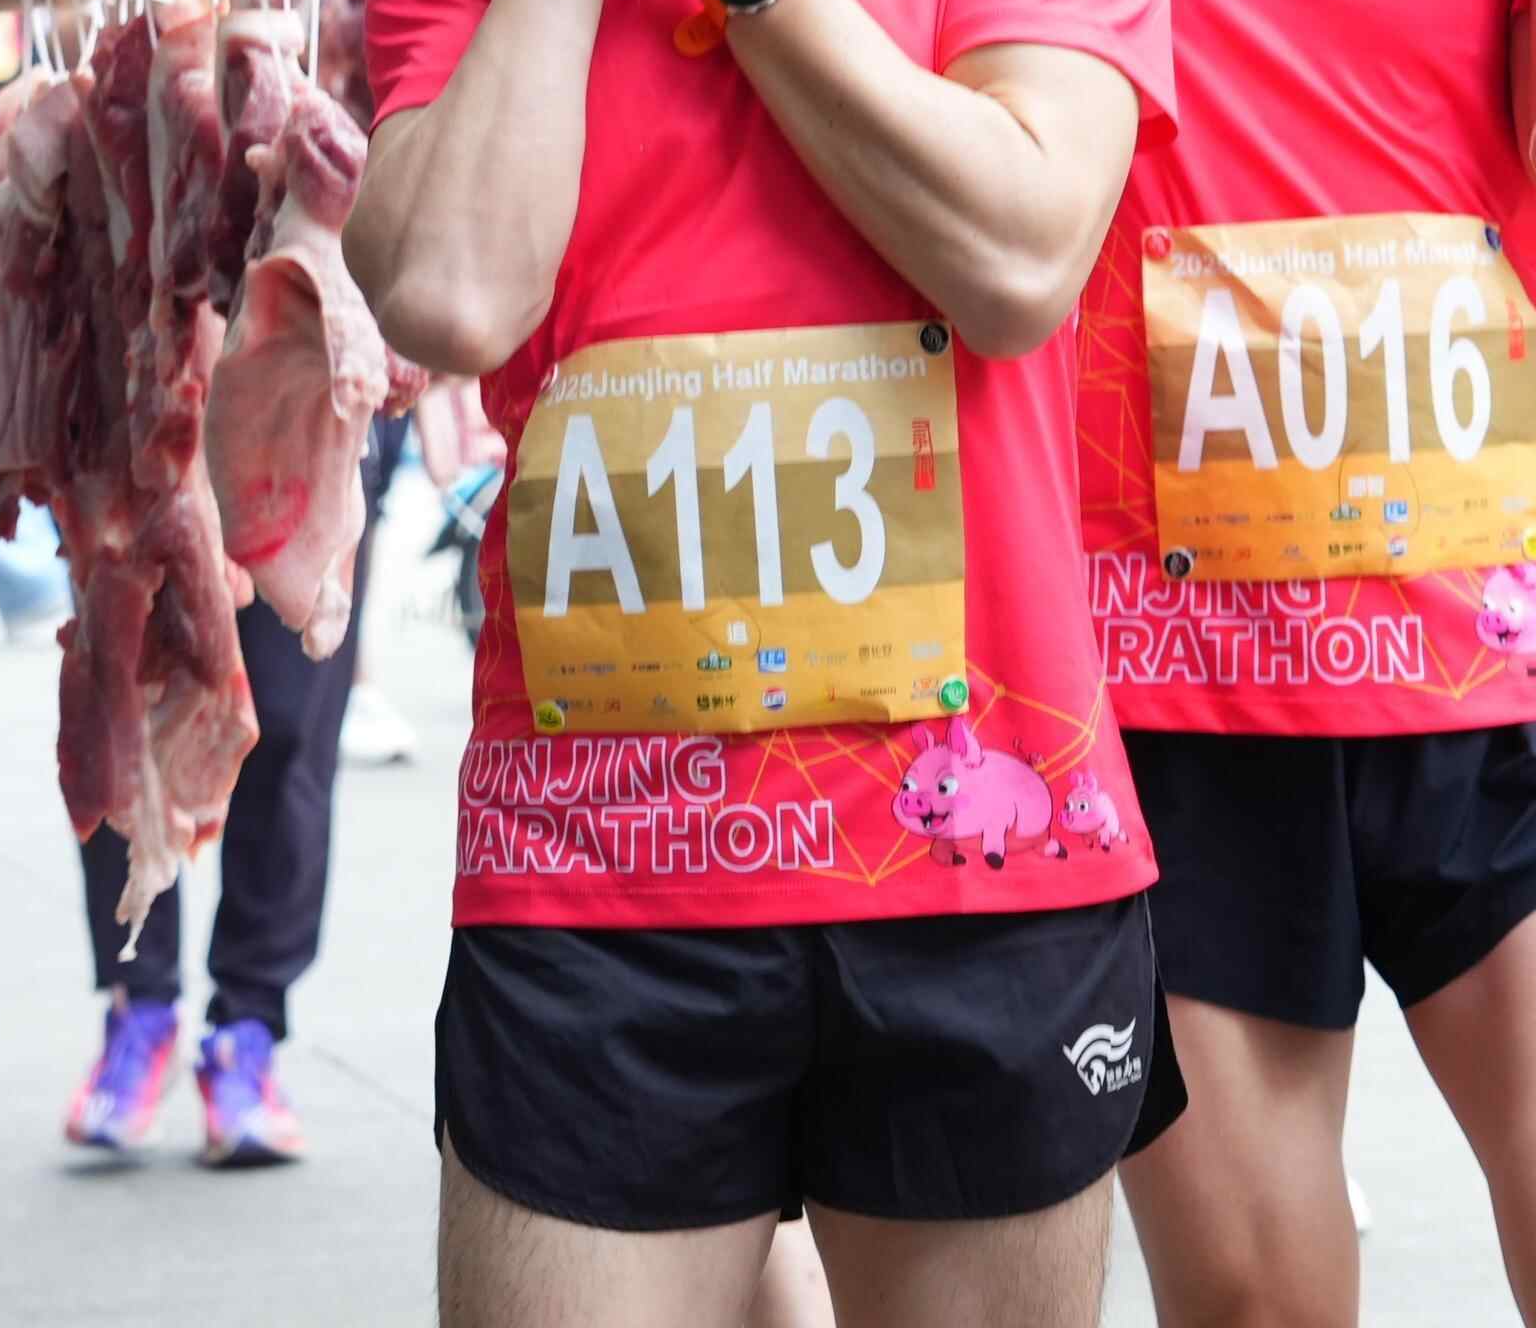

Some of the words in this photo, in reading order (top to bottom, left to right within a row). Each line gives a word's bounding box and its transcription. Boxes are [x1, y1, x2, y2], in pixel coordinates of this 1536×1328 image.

[1343, 240, 1397, 268] Half
[712, 357, 776, 390] Half
[783, 351, 927, 385] Marathon
[1177, 274, 1491, 472] A016
[543, 396, 887, 618] A113
[462, 735, 727, 806] UNJING
